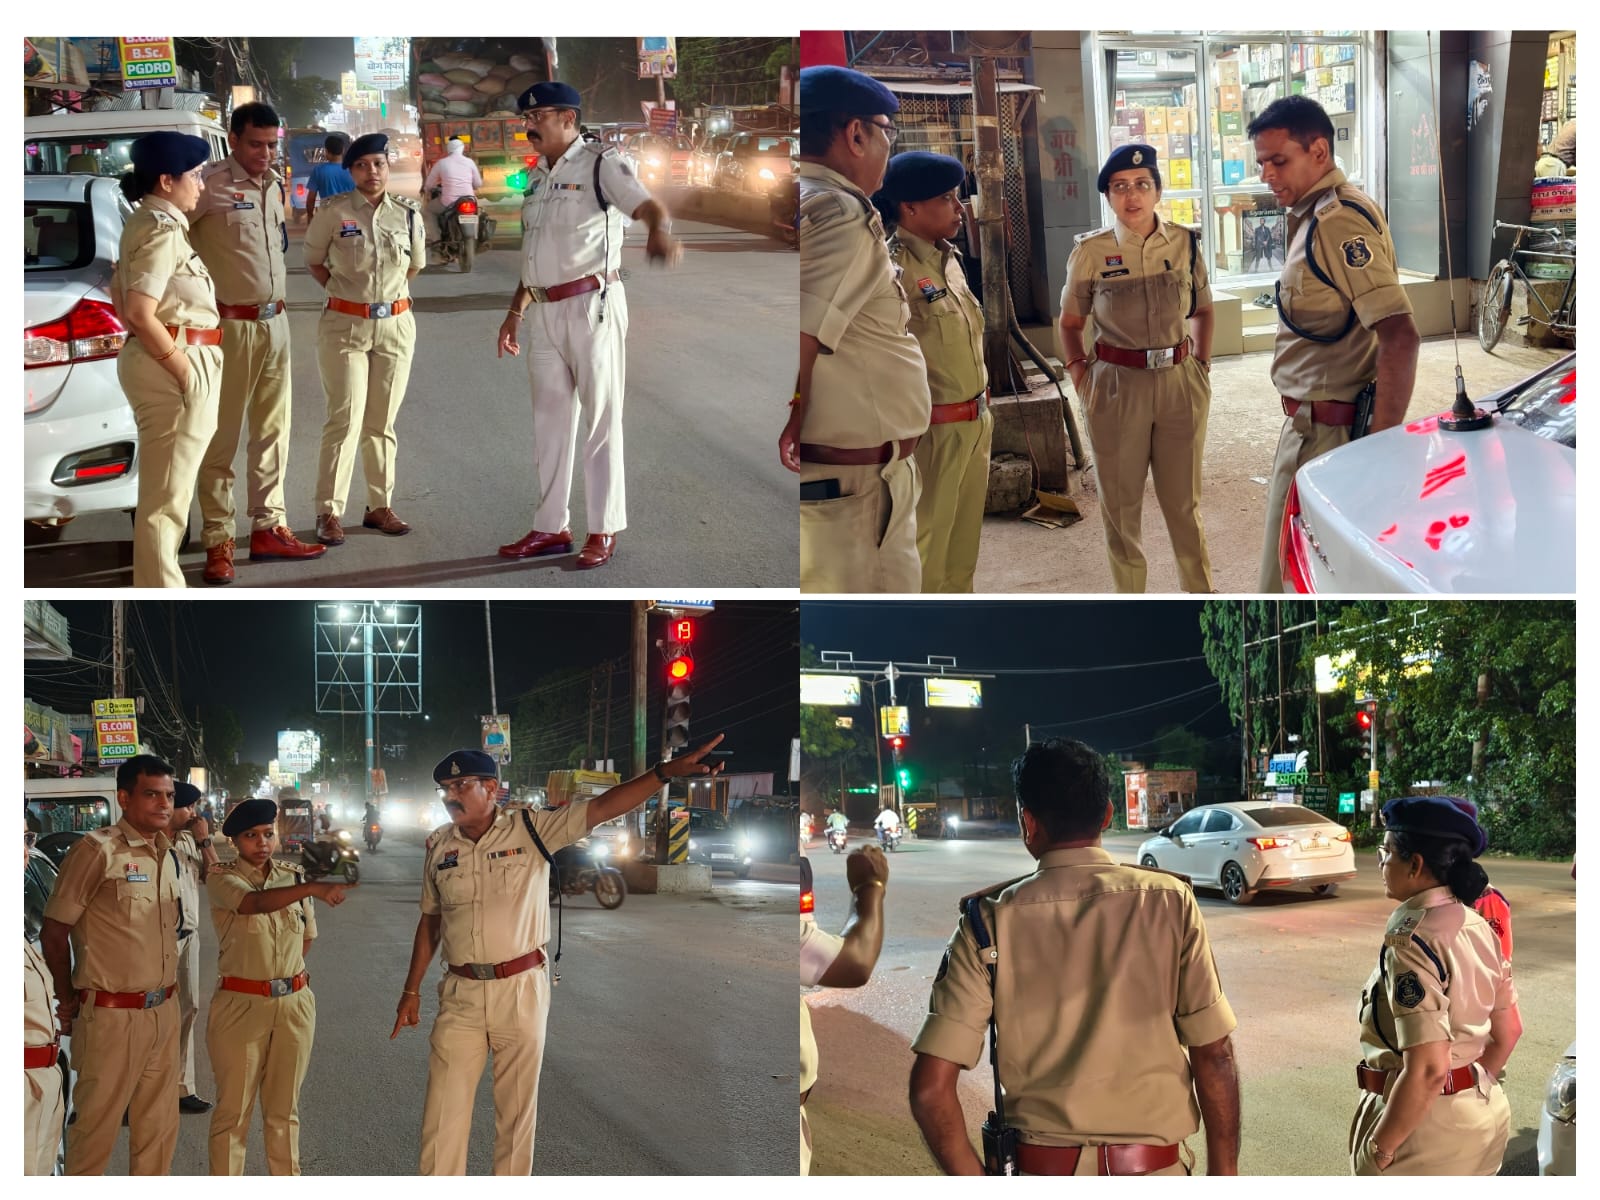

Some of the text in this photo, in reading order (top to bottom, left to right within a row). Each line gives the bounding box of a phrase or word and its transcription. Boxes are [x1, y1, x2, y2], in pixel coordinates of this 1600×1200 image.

[132, 47, 163, 59] B.Sc.
[127, 62, 171, 75] PGDRD
[678, 621, 690, 639] 19
[101, 722, 132, 731] B.COM
[106, 734, 129, 743] B.Sc.
[102, 746, 135, 756] PGDRD
